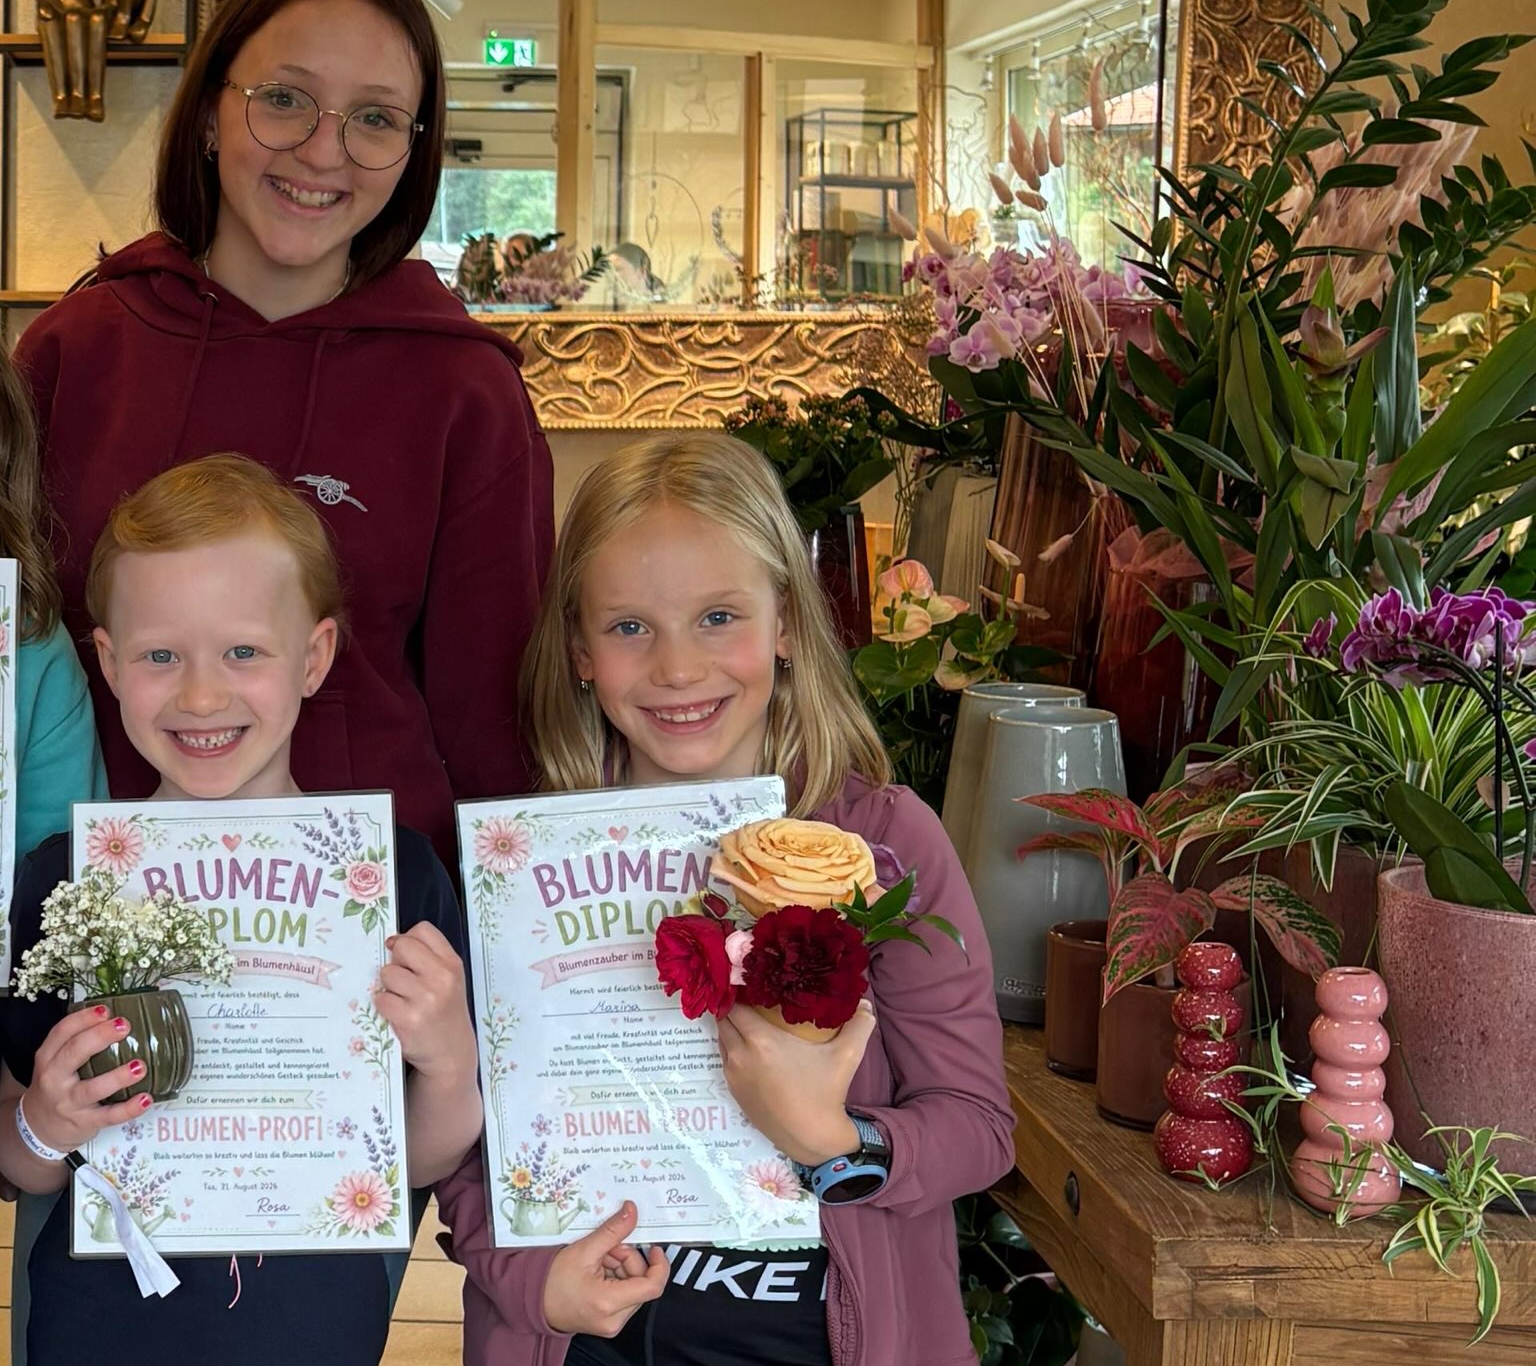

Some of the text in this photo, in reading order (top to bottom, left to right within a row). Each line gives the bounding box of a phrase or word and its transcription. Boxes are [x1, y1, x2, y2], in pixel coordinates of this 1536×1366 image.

[142, 858, 340, 908] BLUMEN-
[207, 907, 308, 947] PLOM
[554, 899, 683, 946] DIPLO
[237, 957, 250, 968] im
[558, 952, 629, 973] Blumenzauber
[632, 951, 644, 960] im
[569, 987, 595, 995] Hiermit
[597, 985, 612, 994] wird
[614, 984, 641, 993] feierlich
[207, 1002, 268, 1018] Charlotte
[624, 1016, 644, 1024] Name
[659, 1028, 672, 1036] und
[674, 1026, 703, 1035] Geschick
[668, 1053, 681, 1061] und
[186, 1095, 208, 1104] Dafür
[590, 1090, 612, 1099] Dafür
[157, 1116, 323, 1142] BLUMEN-PROFI
[622, 1144, 644, 1153] kreativ
[646, 1143, 659, 1152] und
[675, 1142, 686, 1150] die
[239, 1151, 253, 1159] und
[270, 1151, 281, 1159] die
[282, 1151, 308, 1159] Blumen
[642, 1174, 665, 1184] August
[233, 1182, 257, 1192] August
[666, 1188, 699, 1204] Rosa
[257, 1196, 291, 1213] Rosa
